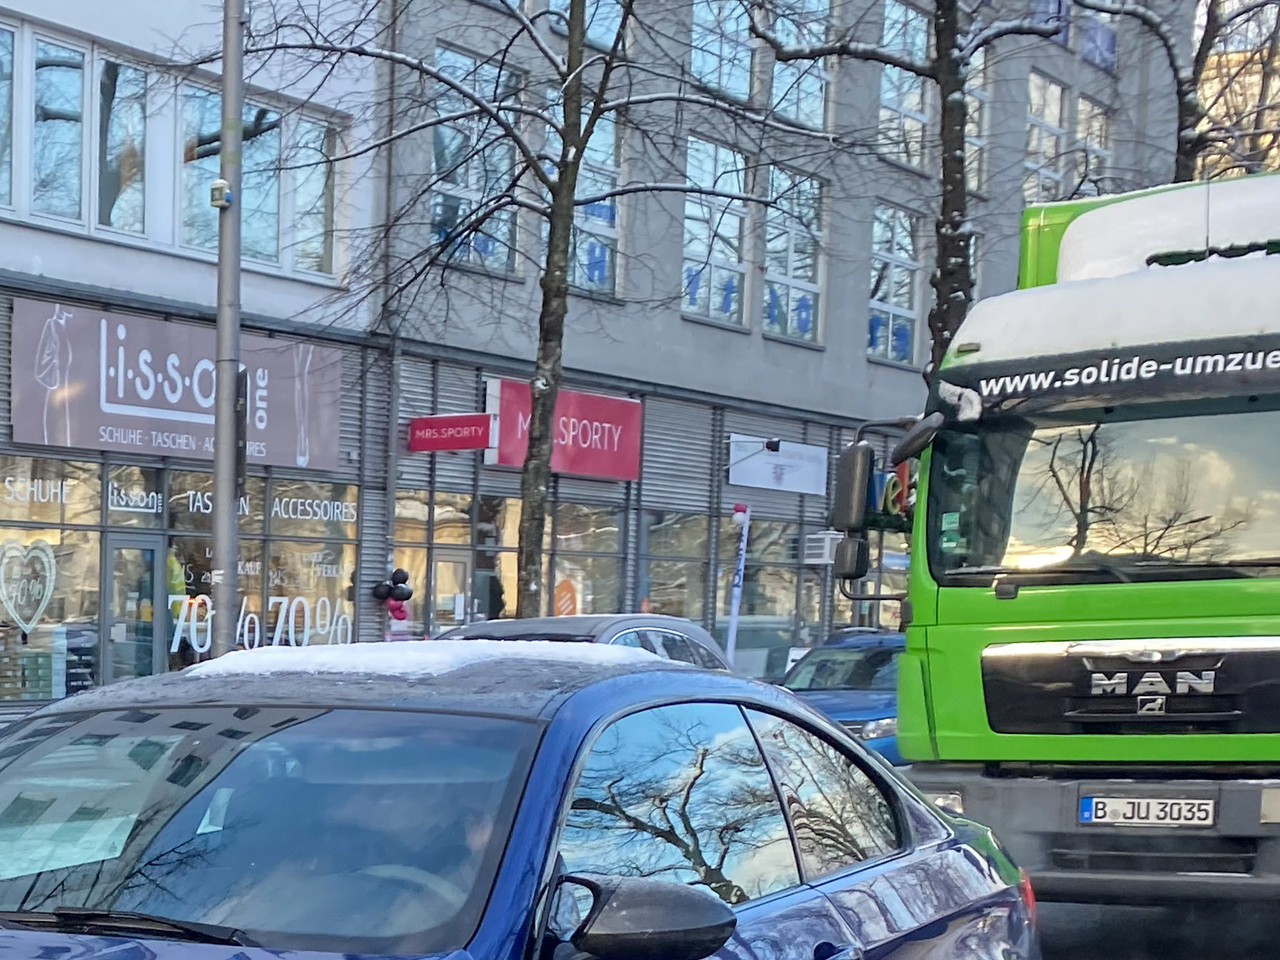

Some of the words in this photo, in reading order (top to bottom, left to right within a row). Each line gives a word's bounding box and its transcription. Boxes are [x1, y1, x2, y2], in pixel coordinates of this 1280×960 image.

[255, 367, 269, 430] one
[98, 425, 143, 445] SCHUHE
[151, 430, 196, 450] TASCHEN
[414, 426, 485, 440] MRS.SPORTY
[518, 411, 623, 452] M.SPORTY
[4, 476, 71, 504] SCHUHE
[271, 497, 357, 522] ACCESSOIRES
[269, 596, 353, 647] 70%
[1091, 671, 1215, 695] MAN
[1094, 801, 1107, 819] B
[1123, 801, 1150, 820] JU
[1156, 802, 1209, 821] 3035
